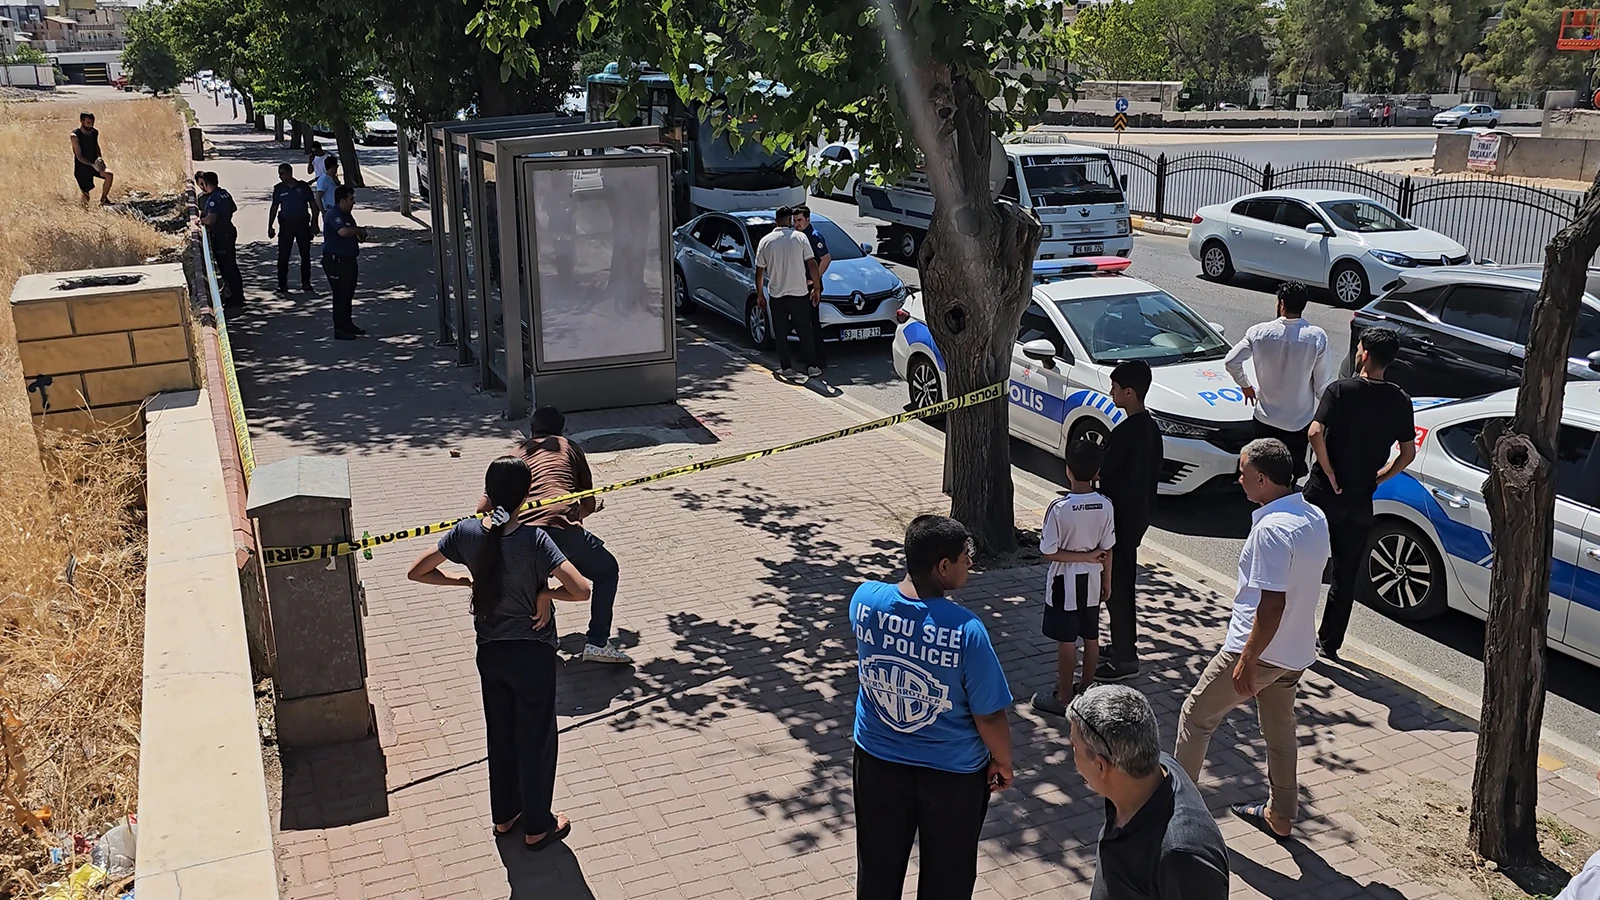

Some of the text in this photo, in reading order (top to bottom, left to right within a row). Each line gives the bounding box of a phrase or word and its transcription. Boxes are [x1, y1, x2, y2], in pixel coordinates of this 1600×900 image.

[857, 329, 864, 337] ET
[869, 328, 880, 336] 212
[1009, 384, 1044, 412] OLİS
[856, 602, 962, 650] IF YOU SEE
[856, 624, 959, 668] DA POLICE!
